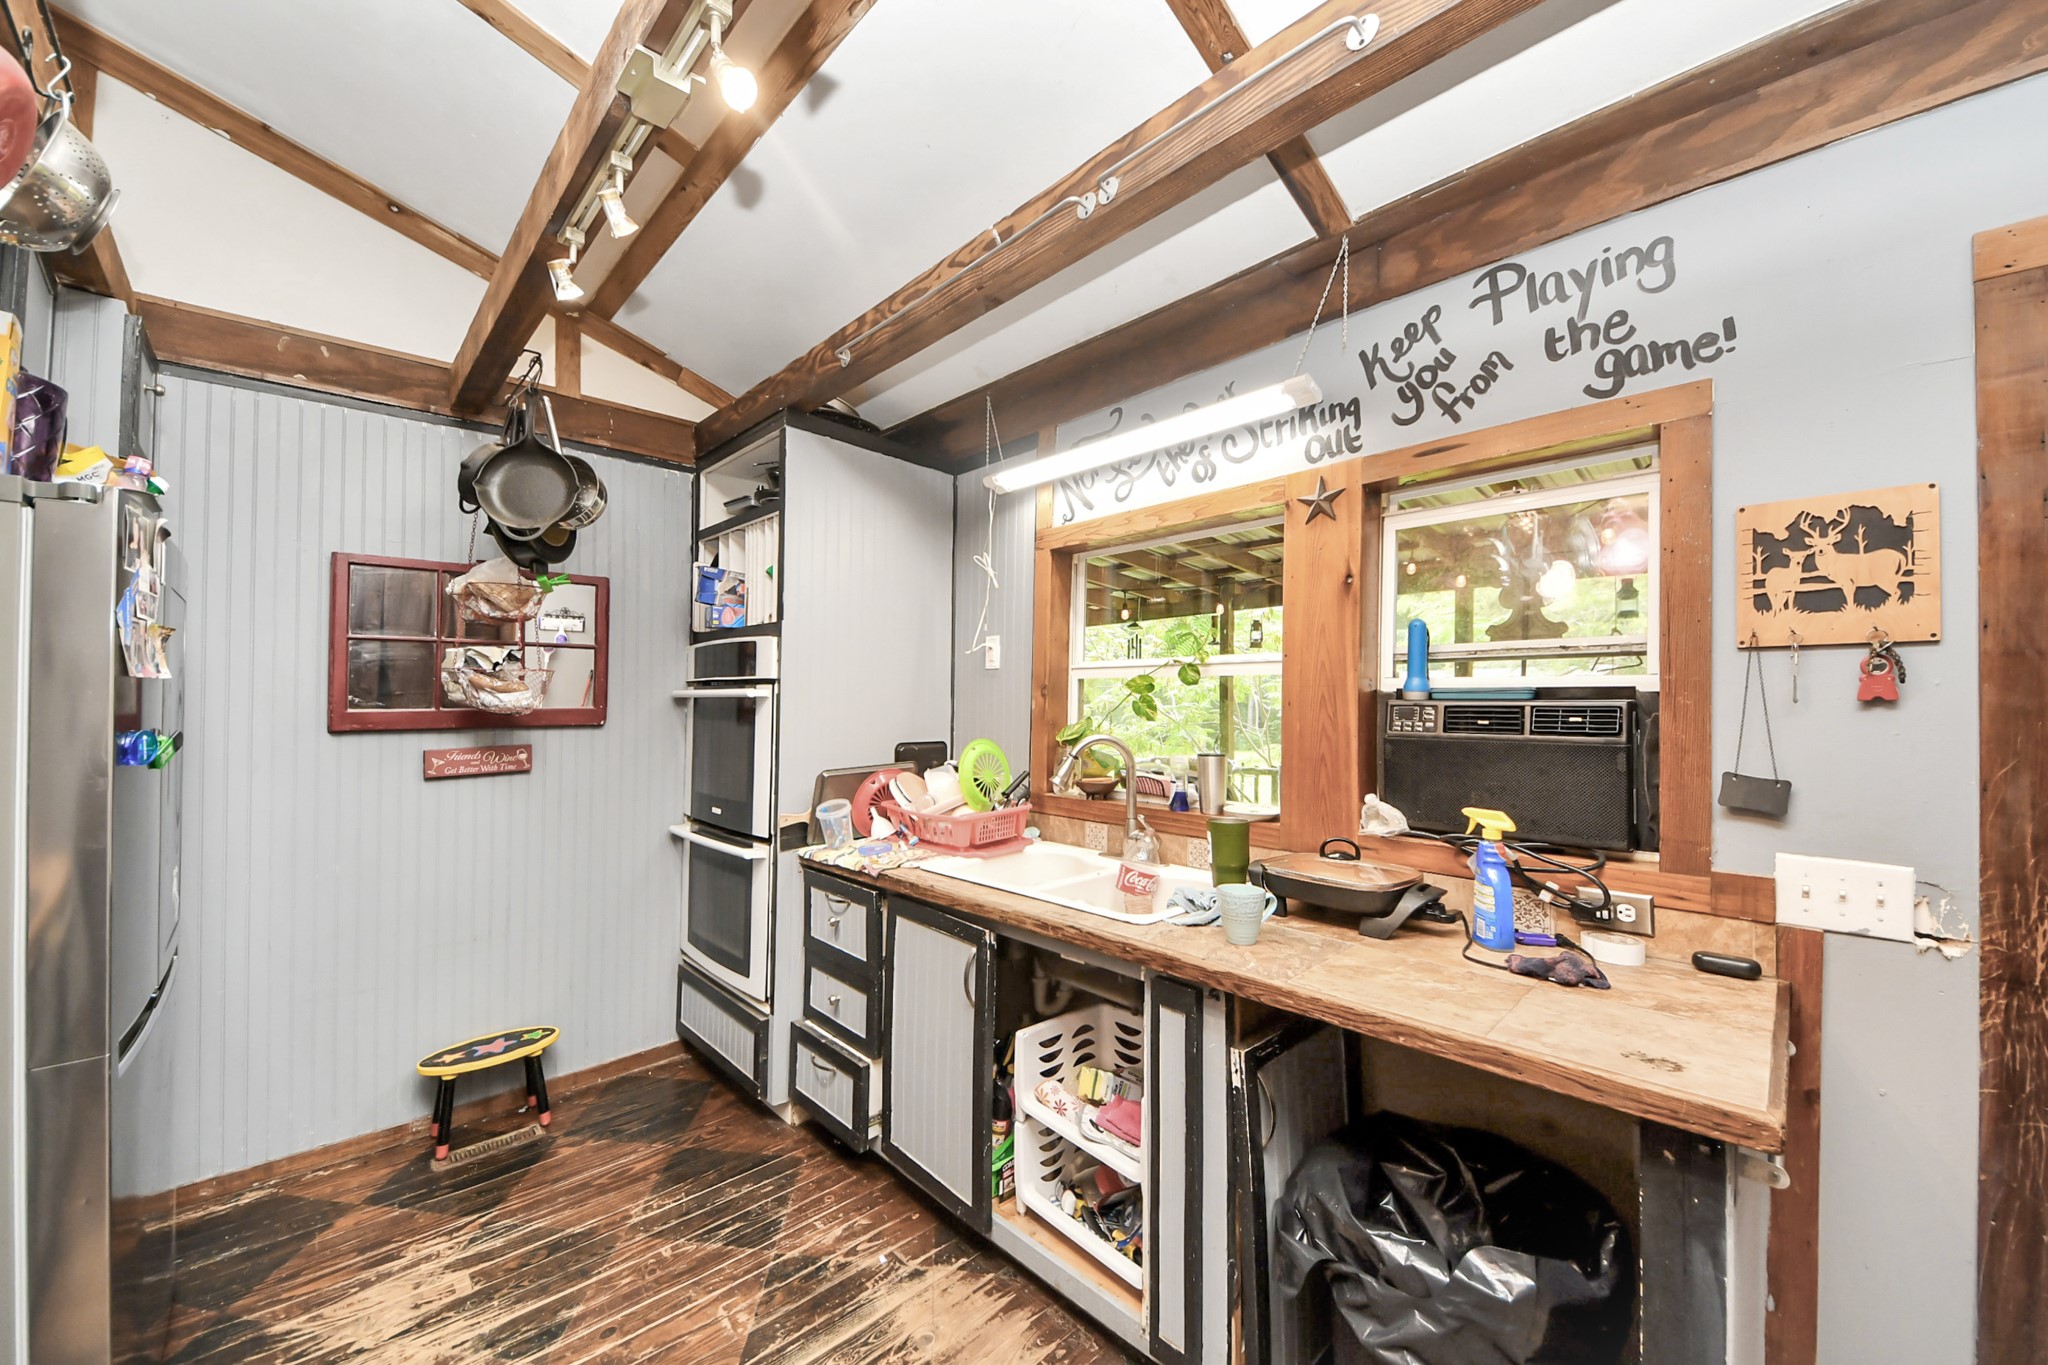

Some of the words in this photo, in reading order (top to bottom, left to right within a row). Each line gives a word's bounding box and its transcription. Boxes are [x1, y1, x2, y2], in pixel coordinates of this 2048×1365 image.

[1468, 235, 1676, 326] Playing
[1358, 304, 1442, 390] Keep
[1544, 309, 1637, 362] the
[1582, 316, 1737, 399] game!
[1391, 347, 1457, 426] you
[1431, 351, 1514, 424] from
[444, 766, 457, 775] Get
[459, 766, 479, 774] Better
[480, 764, 498, 772] With
[500, 763, 517, 771] Time
[446, 750, 481, 761] Friends
